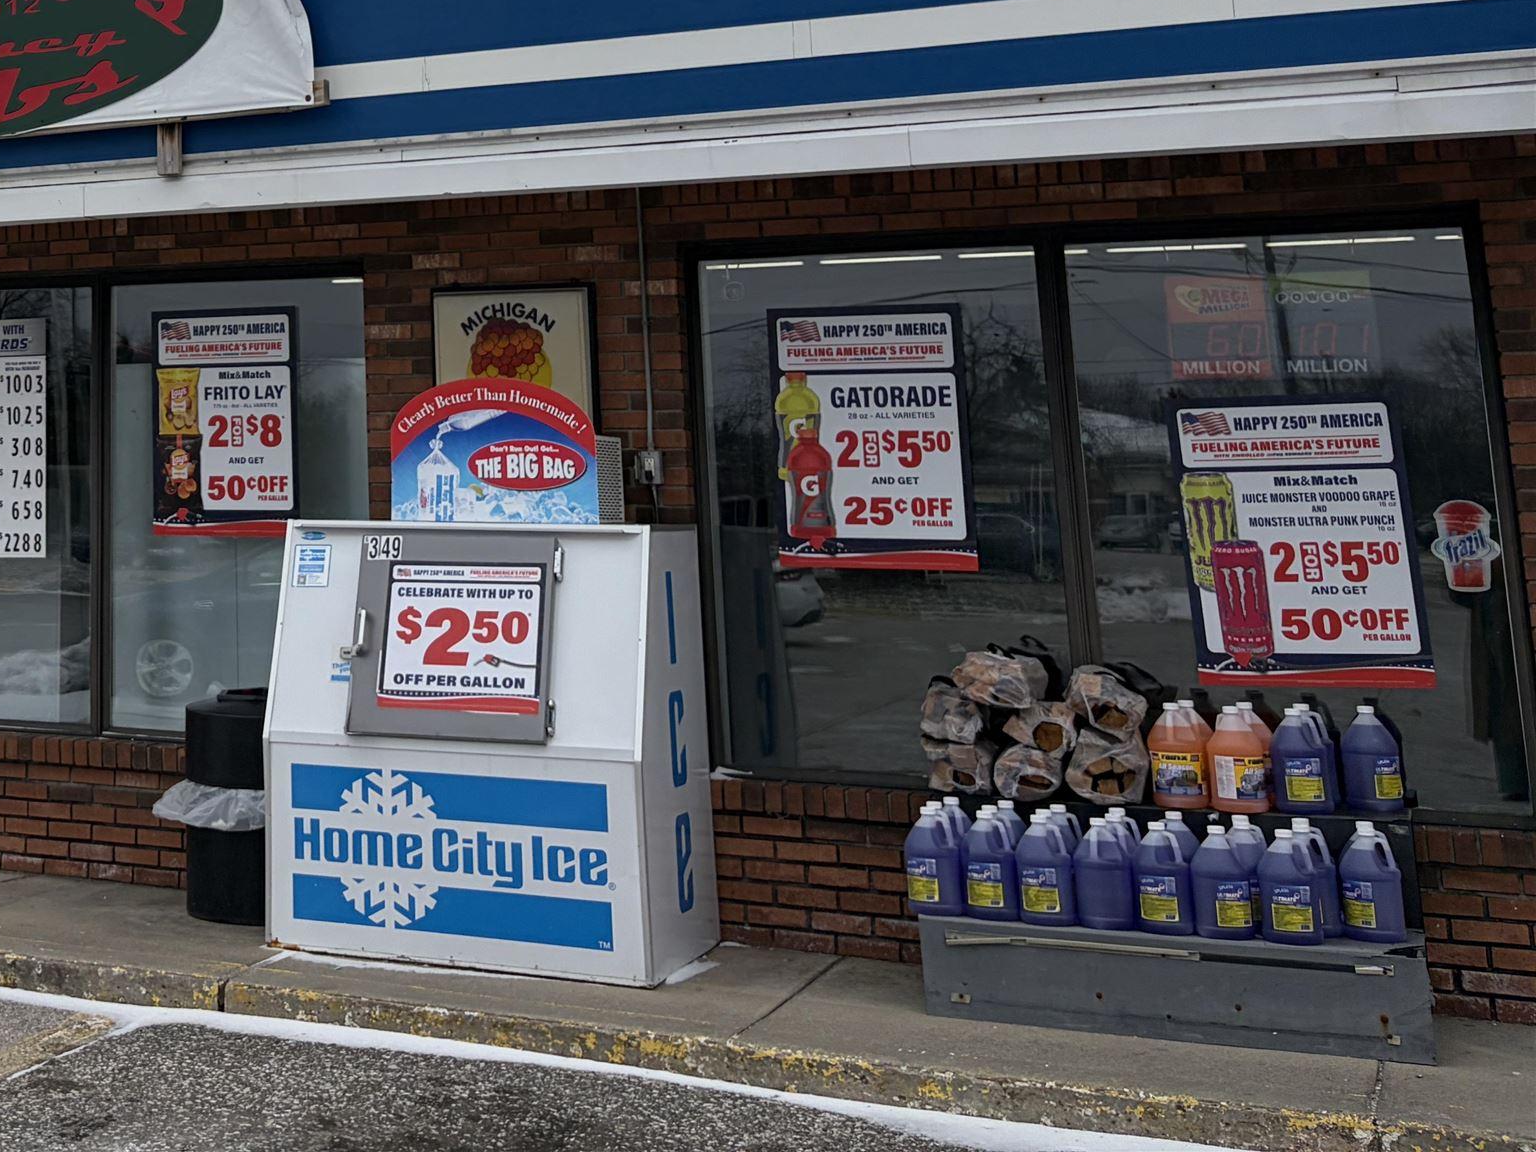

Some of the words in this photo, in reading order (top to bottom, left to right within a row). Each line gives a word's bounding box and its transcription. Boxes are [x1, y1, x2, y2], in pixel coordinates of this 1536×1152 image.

[1198, 286, 1249, 305] MEGA
[460, 302, 556, 336] MICHIGAN
[3, 324, 24, 335] WITH
[193, 325, 221, 336] HAPPY
[246, 322, 285, 334] AMERICA
[823, 324, 860, 338] HAPPY
[895, 322, 947, 336] AMERICA
[165, 344, 200, 353] FUELING
[202, 342, 247, 352] AMERICA'S
[249, 341, 282, 351] FUTURE
[787, 347, 833, 357] FUELING
[835, 345, 897, 356] AMERICA'S
[899, 344, 943, 355] FUTURE
[1182, 359, 1261, 374] MILLION
[1287, 359, 1368, 373] MILLION
[219, 370, 271, 379] Mix&Match
[204, 386, 250, 401] FRITO
[255, 385, 284, 399] LAY
[830, 386, 952, 408] GATORADE
[398, 403, 436, 433] Clearly
[434, 392, 473, 409] Better
[474, 388, 507, 401] Than
[1233, 415, 1279, 431] HAPPY
[1320, 413, 1383, 428] AMERICA
[208, 415, 229, 447] 2
[232, 417, 242, 446] FOR
[246, 414, 282, 447] $8
[835, 430, 860, 468] 2
[865, 433, 879, 466] FOR
[1191, 441, 1248, 453] FUELING
[1251, 439, 1324, 452] AMERICA'S
[1327, 437, 1380, 449] FUTURE
[475, 458, 502, 479] THE
[506, 453, 539, 479] BIG
[542, 457, 576, 480] BAG
[257, 475, 288, 493] OFF
[800, 475, 820, 496] G
[871, 477, 895, 485] AND
[898, 477, 919, 485] GET
[1273, 475, 1358, 486] Mix&Match
[1242, 493, 1268, 504] JUICE
[1270, 492, 1318, 503] MONSTER
[1320, 491, 1360, 502] VOODOO
[1362, 490, 1396, 501] GRAPE
[911, 498, 952, 517] OFF
[1312, 505, 1327, 513] AND
[1249, 517, 1295, 527] MONSTER
[1298, 516, 1328, 527] ULTRA
[1331, 516, 1359, 526] PUNK
[1361, 515, 1395, 526] PUNCH
[1445, 529, 1487, 563] frazil
[1270, 541, 1299, 582] 2
[1303, 544, 1319, 580] FOR
[398, 587, 464, 598] CELEBRATE
[467, 588, 496, 598] WITH
[499, 589, 515, 599] UP
[517, 590, 533, 600] TO
[1311, 586, 1339, 595] AND
[1342, 586, 1368, 595] GET
[1360, 608, 1409, 630] OFF
[394, 673, 423, 685] OFF
[426, 675, 457, 687] PER
[460, 676, 525, 689] GALLON
[294, 817, 423, 870] Home
[432, 828, 524, 889] City
[531, 835, 608, 886] Ice
